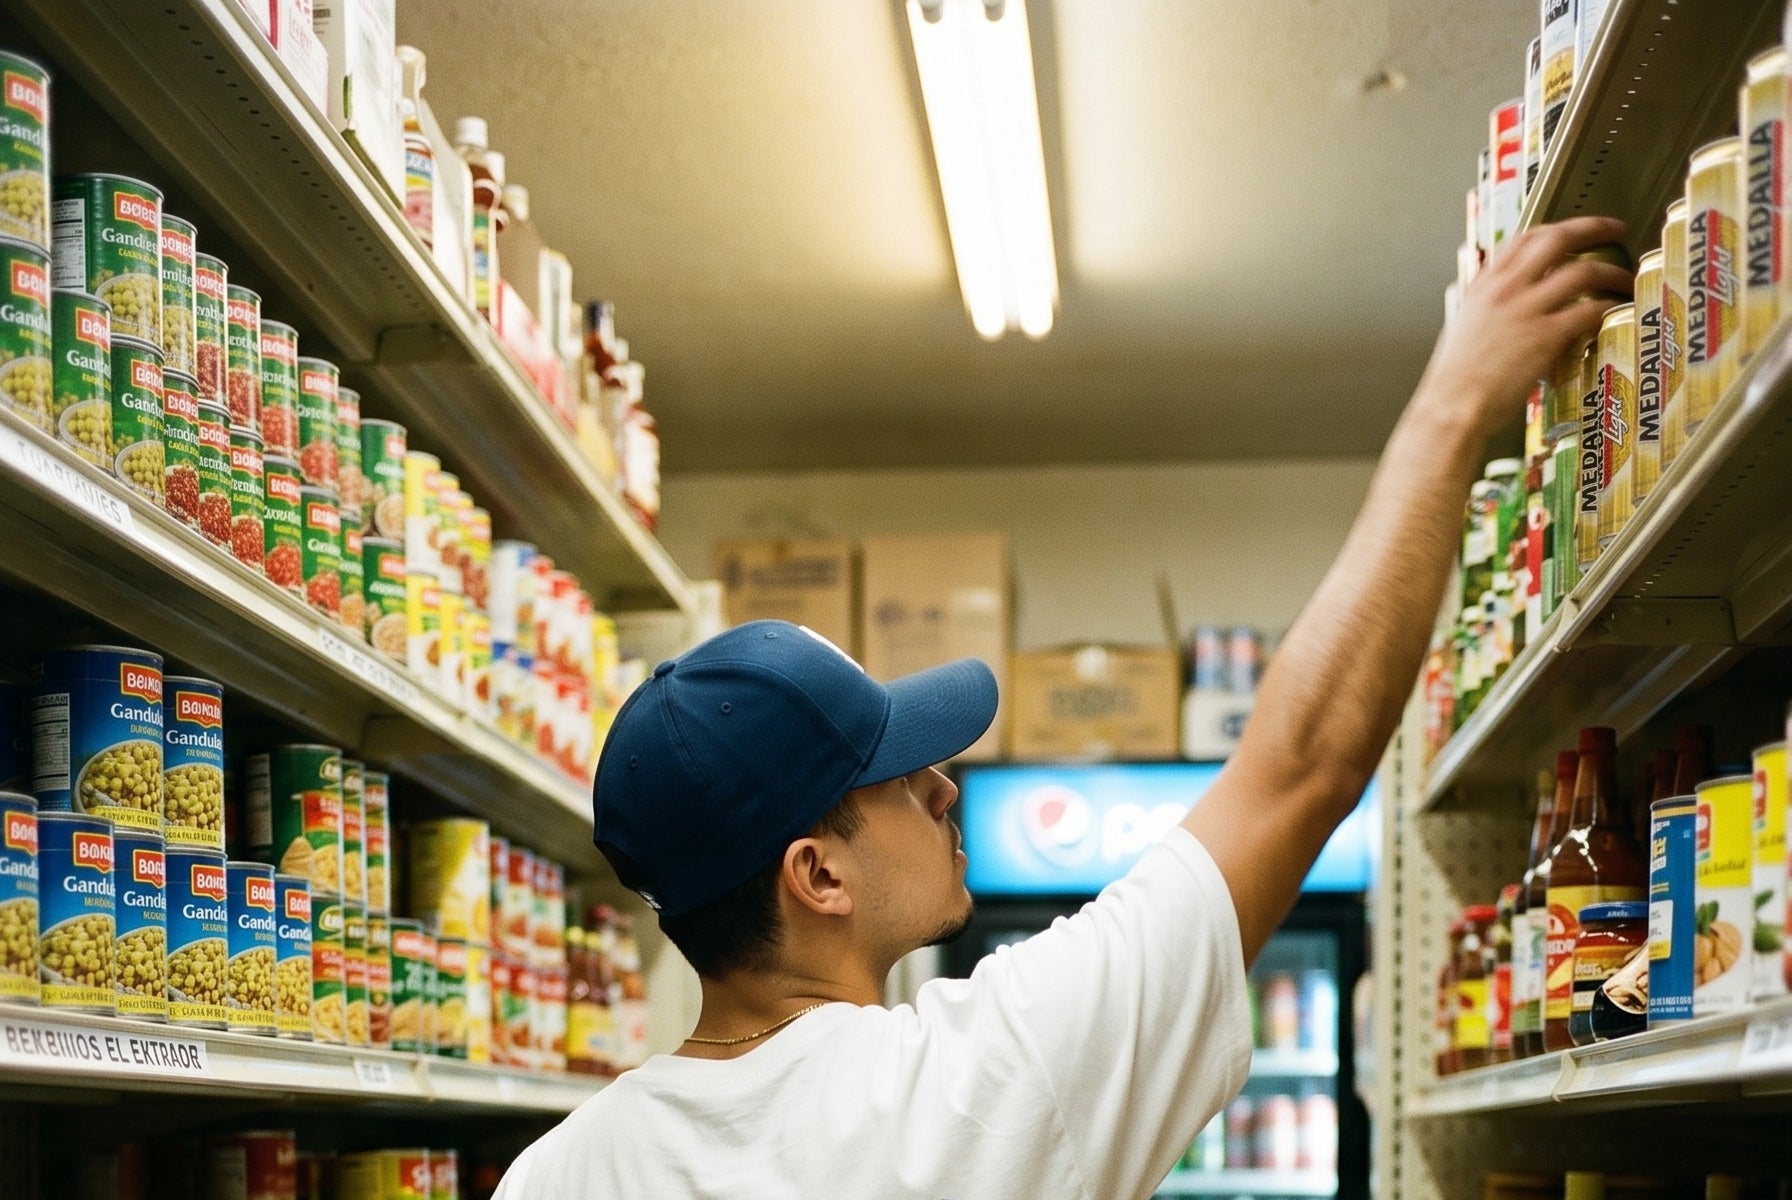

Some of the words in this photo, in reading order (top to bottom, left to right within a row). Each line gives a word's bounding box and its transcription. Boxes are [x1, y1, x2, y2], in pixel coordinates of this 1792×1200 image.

[1687, 211, 1709, 363] MEDALLA
[1638, 305, 1662, 442] MEDALLA
[1581, 389, 1599, 511] MEDALLA
[105, 1036, 131, 1064] EL
